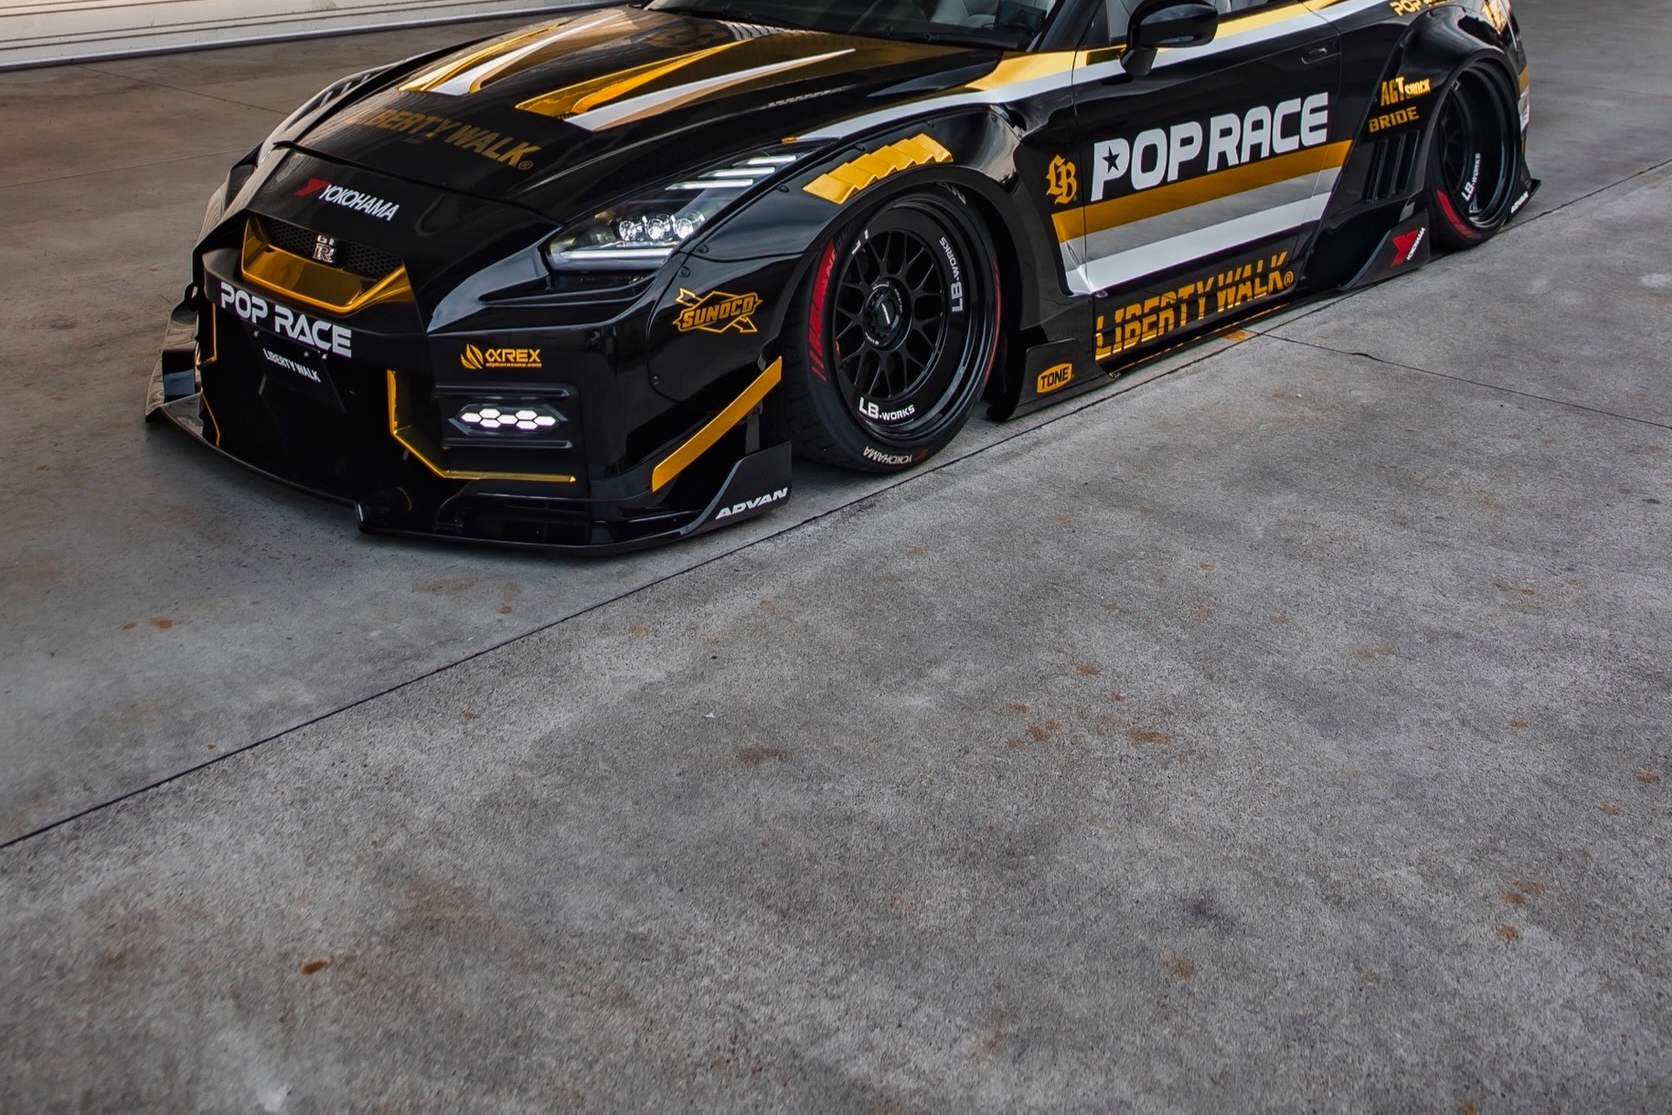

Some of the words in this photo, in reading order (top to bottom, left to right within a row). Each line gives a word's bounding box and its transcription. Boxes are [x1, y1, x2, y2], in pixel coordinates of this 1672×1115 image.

[1380, 76, 1405, 107] AGT
[352, 108, 463, 138] BERTY
[1368, 106, 1419, 133] BRIDE
[1091, 121, 1204, 202] POP
[1207, 91, 1329, 172] RACE
[318, 184, 400, 222] YOKOHAMA
[220, 281, 268, 324] POP
[274, 304, 352, 358] RACE
[681, 294, 756, 329] SUNOCO
[1094, 276, 1215, 362] LIBERTY
[262, 348, 297, 372] LIBERTY
[295, 362, 321, 383] WALK
[1039, 366, 1071, 390] TONE
[863, 445, 913, 465] YOKOHAMA
[715, 486, 789, 520] ADVAN
